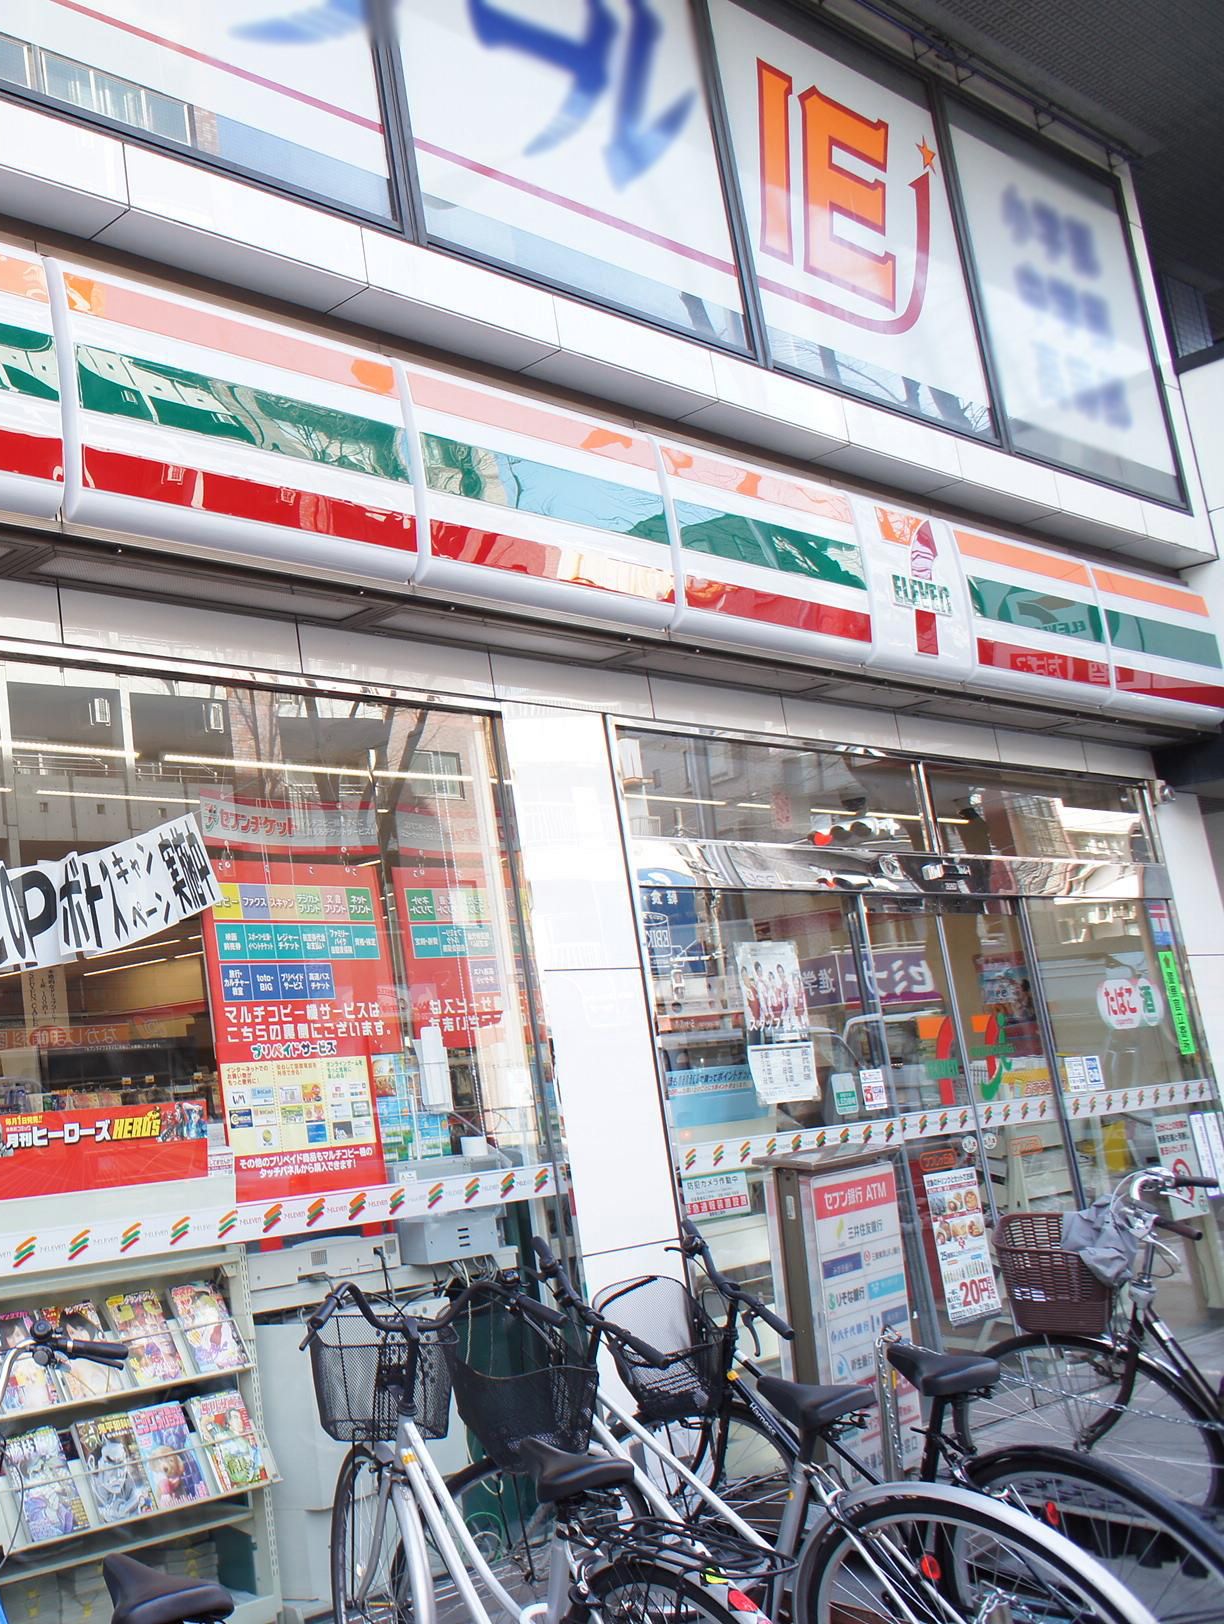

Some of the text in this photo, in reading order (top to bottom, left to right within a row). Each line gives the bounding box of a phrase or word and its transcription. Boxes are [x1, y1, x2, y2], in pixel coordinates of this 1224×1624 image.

[242, 897, 268, 908] ファクス
[270, 898, 295, 908] スキャン
[277, 933, 299, 942] レジャー
[278, 941, 300, 950] チケット
[224, 979, 250, 988] カルチャー
[259, 982, 273, 991] BIG
[280, 973, 304, 982] プリペイド
[284, 981, 304, 990] サービス
[310, 981, 330, 990] チケット
[1104, 986, 1137, 1016] たばこ
[224, 1001, 380, 1024] マルチコピー機サービスは
[250, 1040, 337, 1060] プリペイドサービス
[6, 1118, 111, 1149] 月刊ヒーローズ
[824, 1181, 887, 1211] セブン銀行 ATM
[847, 1219, 884, 1239] 三井住友銀行
[835, 1287, 866, 1307] りそな銀行
[959, 1276, 989, 1308] 20円
[836, 1320, 870, 1341] 八千代銀行
[851, 1352, 874, 1371] 新生銀行
